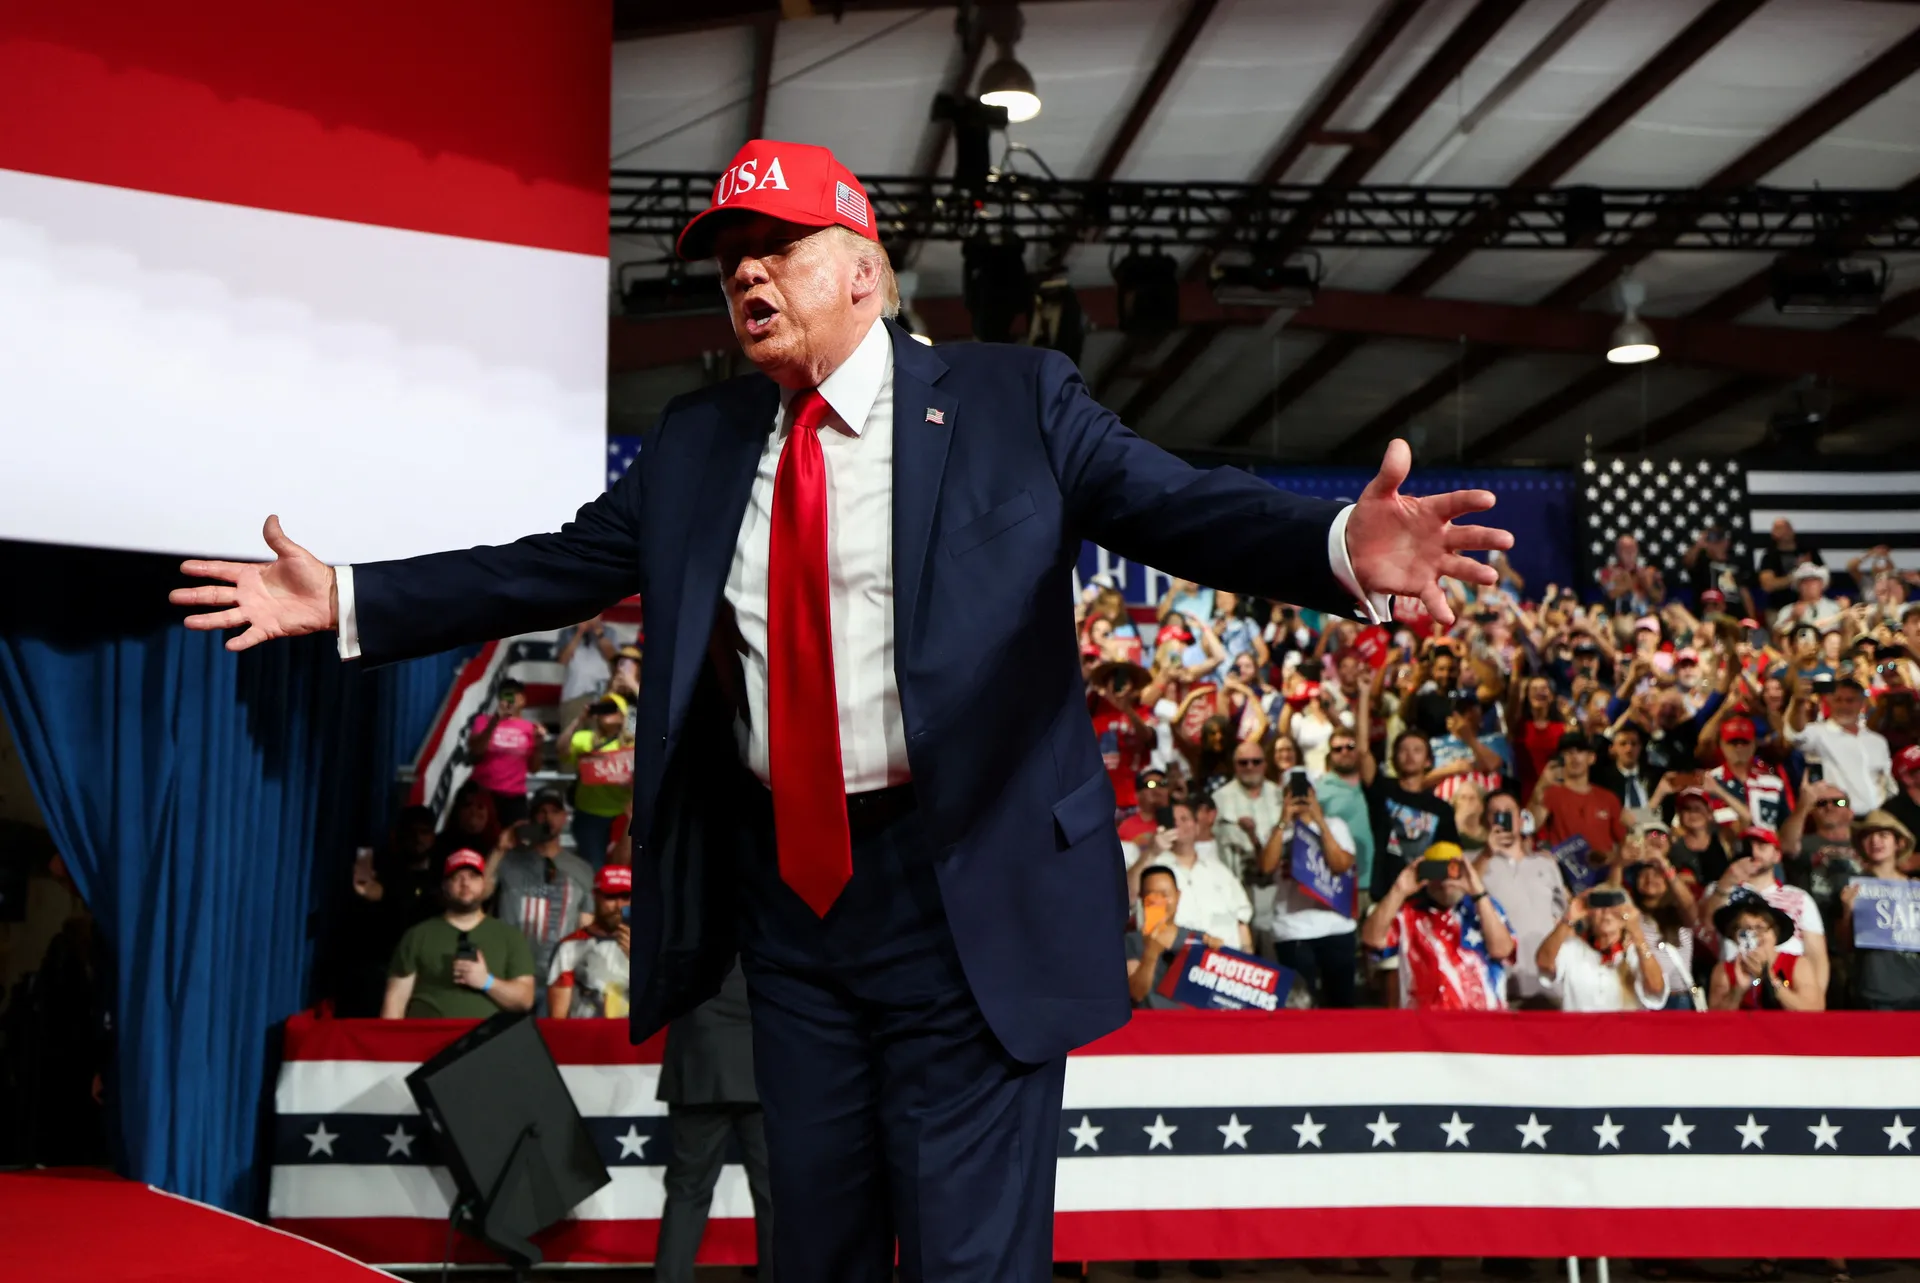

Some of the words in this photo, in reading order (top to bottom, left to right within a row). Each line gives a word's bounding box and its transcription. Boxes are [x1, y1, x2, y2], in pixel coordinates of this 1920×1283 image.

[717, 157, 790, 206] USA
[1187, 965, 1218, 990] OUR
[1214, 977, 1279, 1012] BORDERS
[1204, 952, 1274, 990] PROTECT
